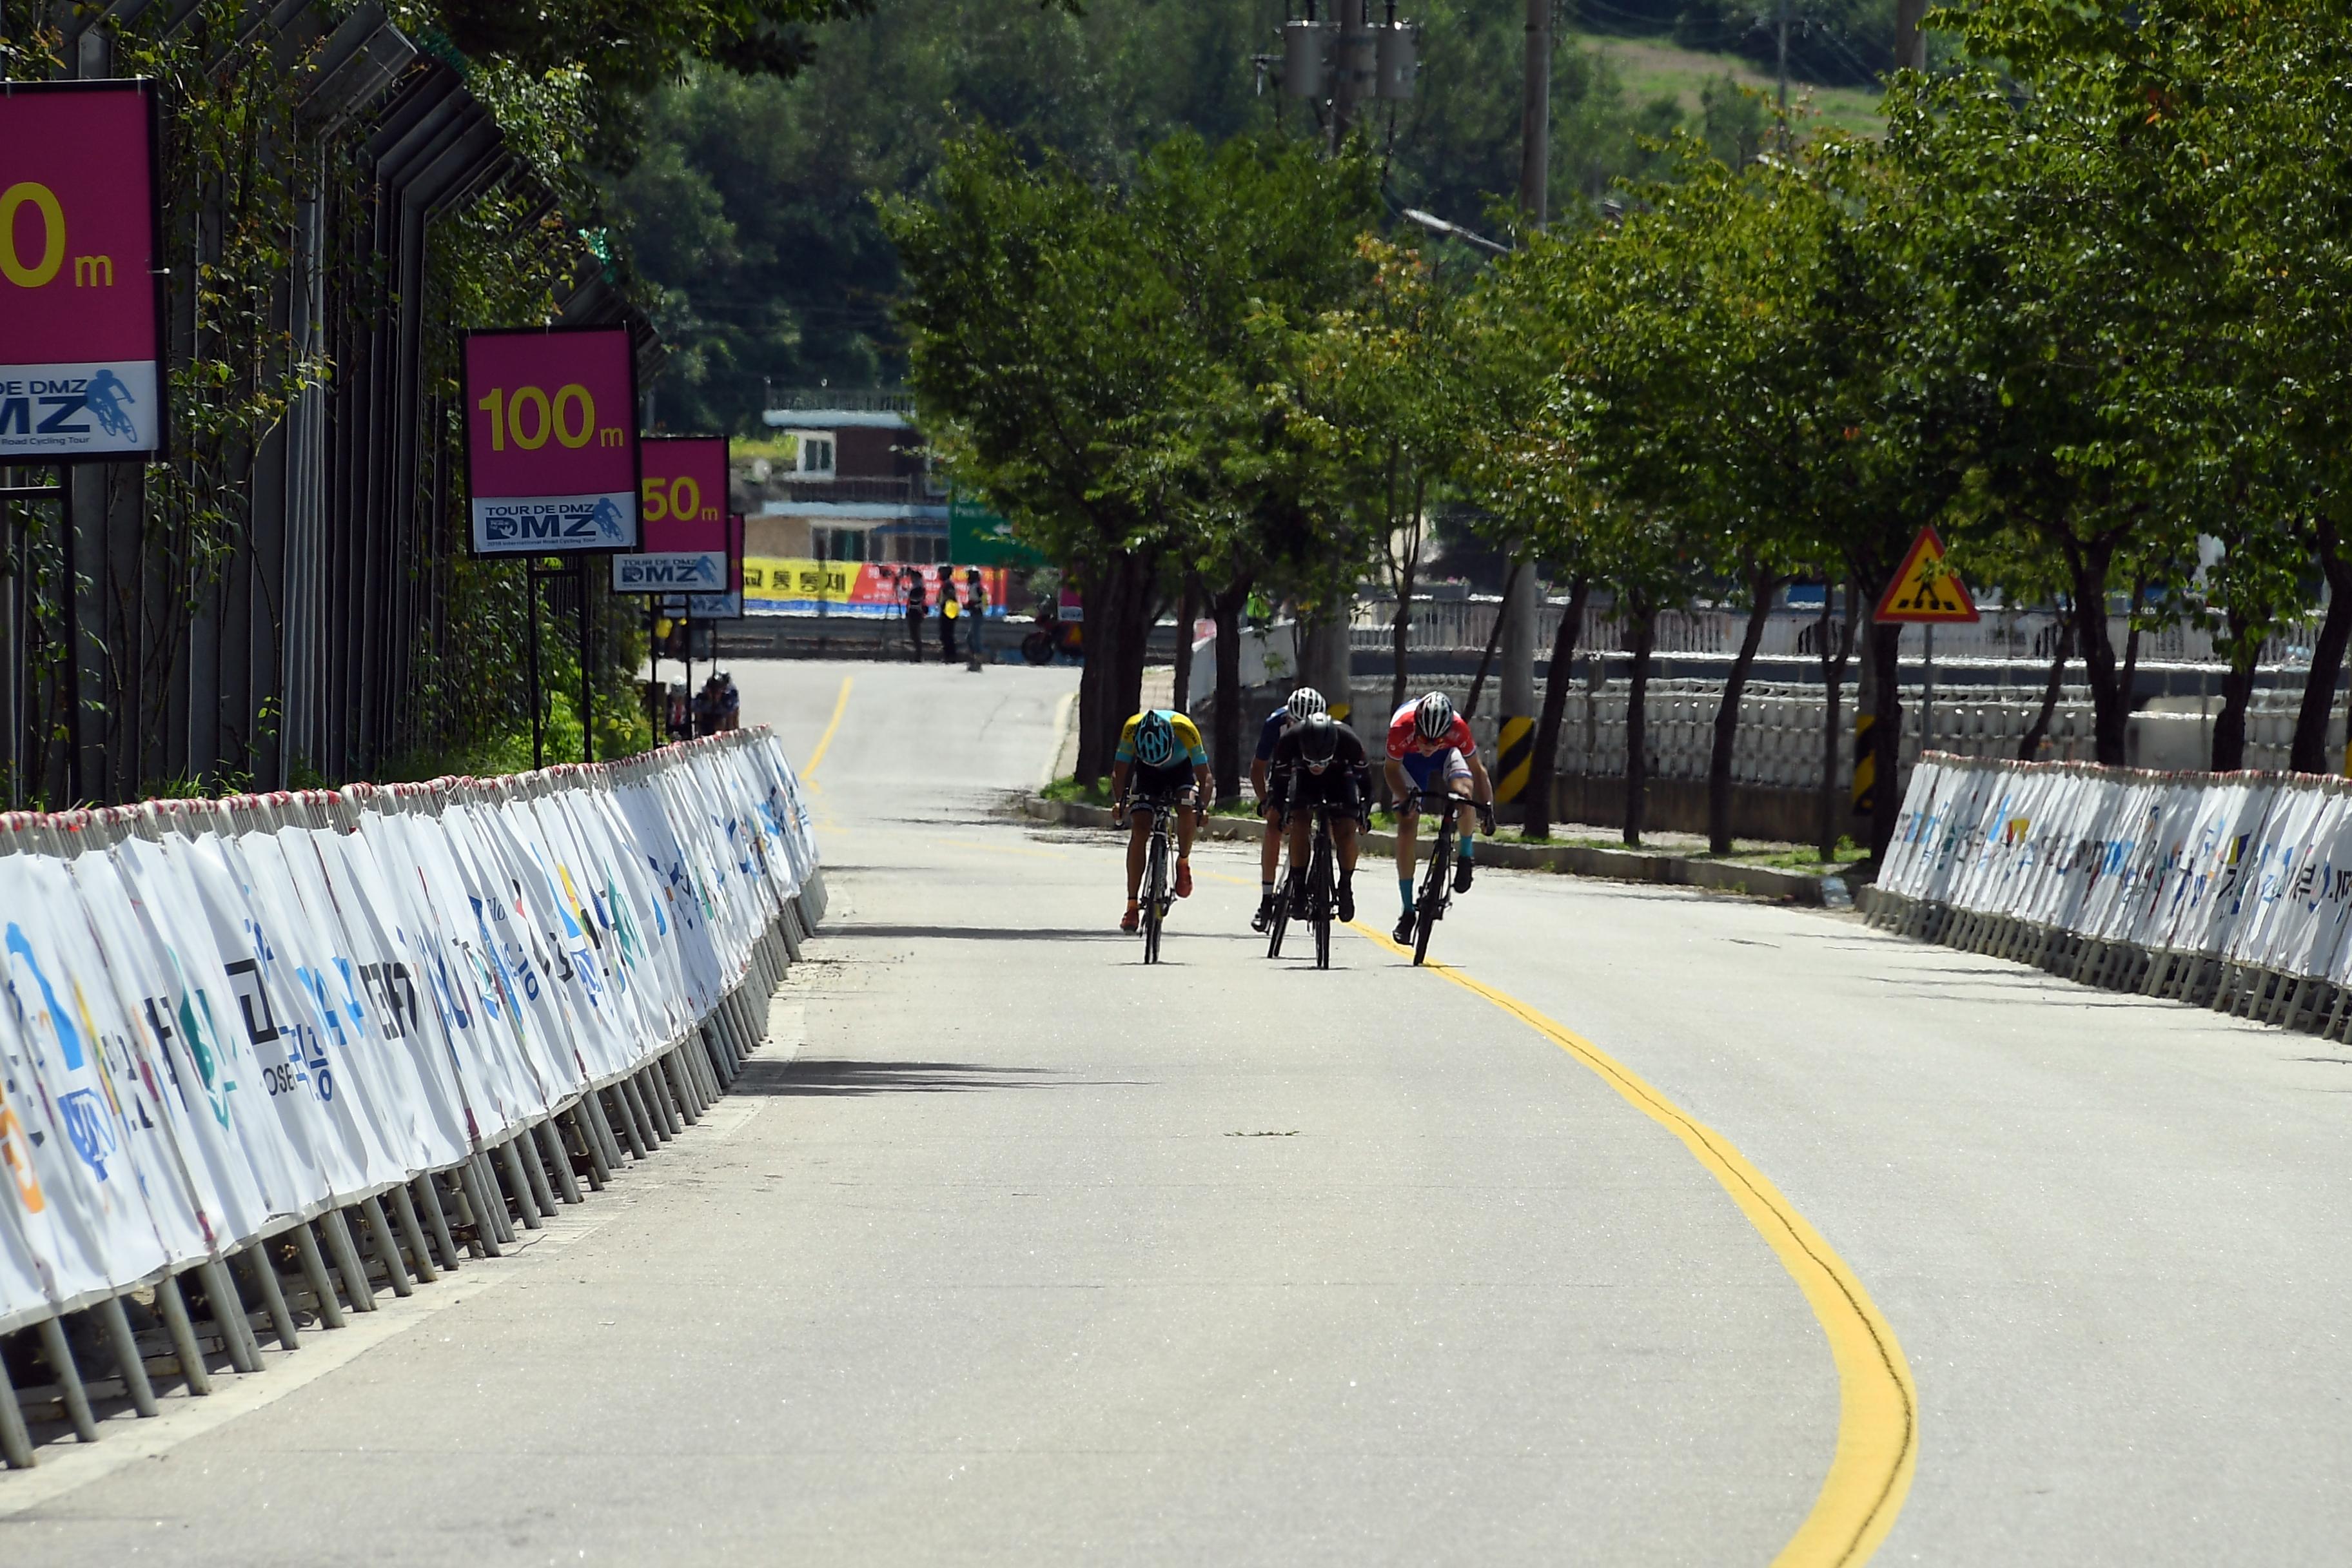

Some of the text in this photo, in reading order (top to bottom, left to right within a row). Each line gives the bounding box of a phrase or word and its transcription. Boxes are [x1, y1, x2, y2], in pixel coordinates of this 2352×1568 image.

[0, 181, 113, 288] 0m
[0, 379, 88, 395] E DMZ
[478, 383, 623, 451] 100m
[29, 437, 65, 446] Cycling
[485, 504, 594, 516] TOUR DE DMZ
[485, 514, 596, 540] DMZ
[622, 565, 698, 583] DMZ
